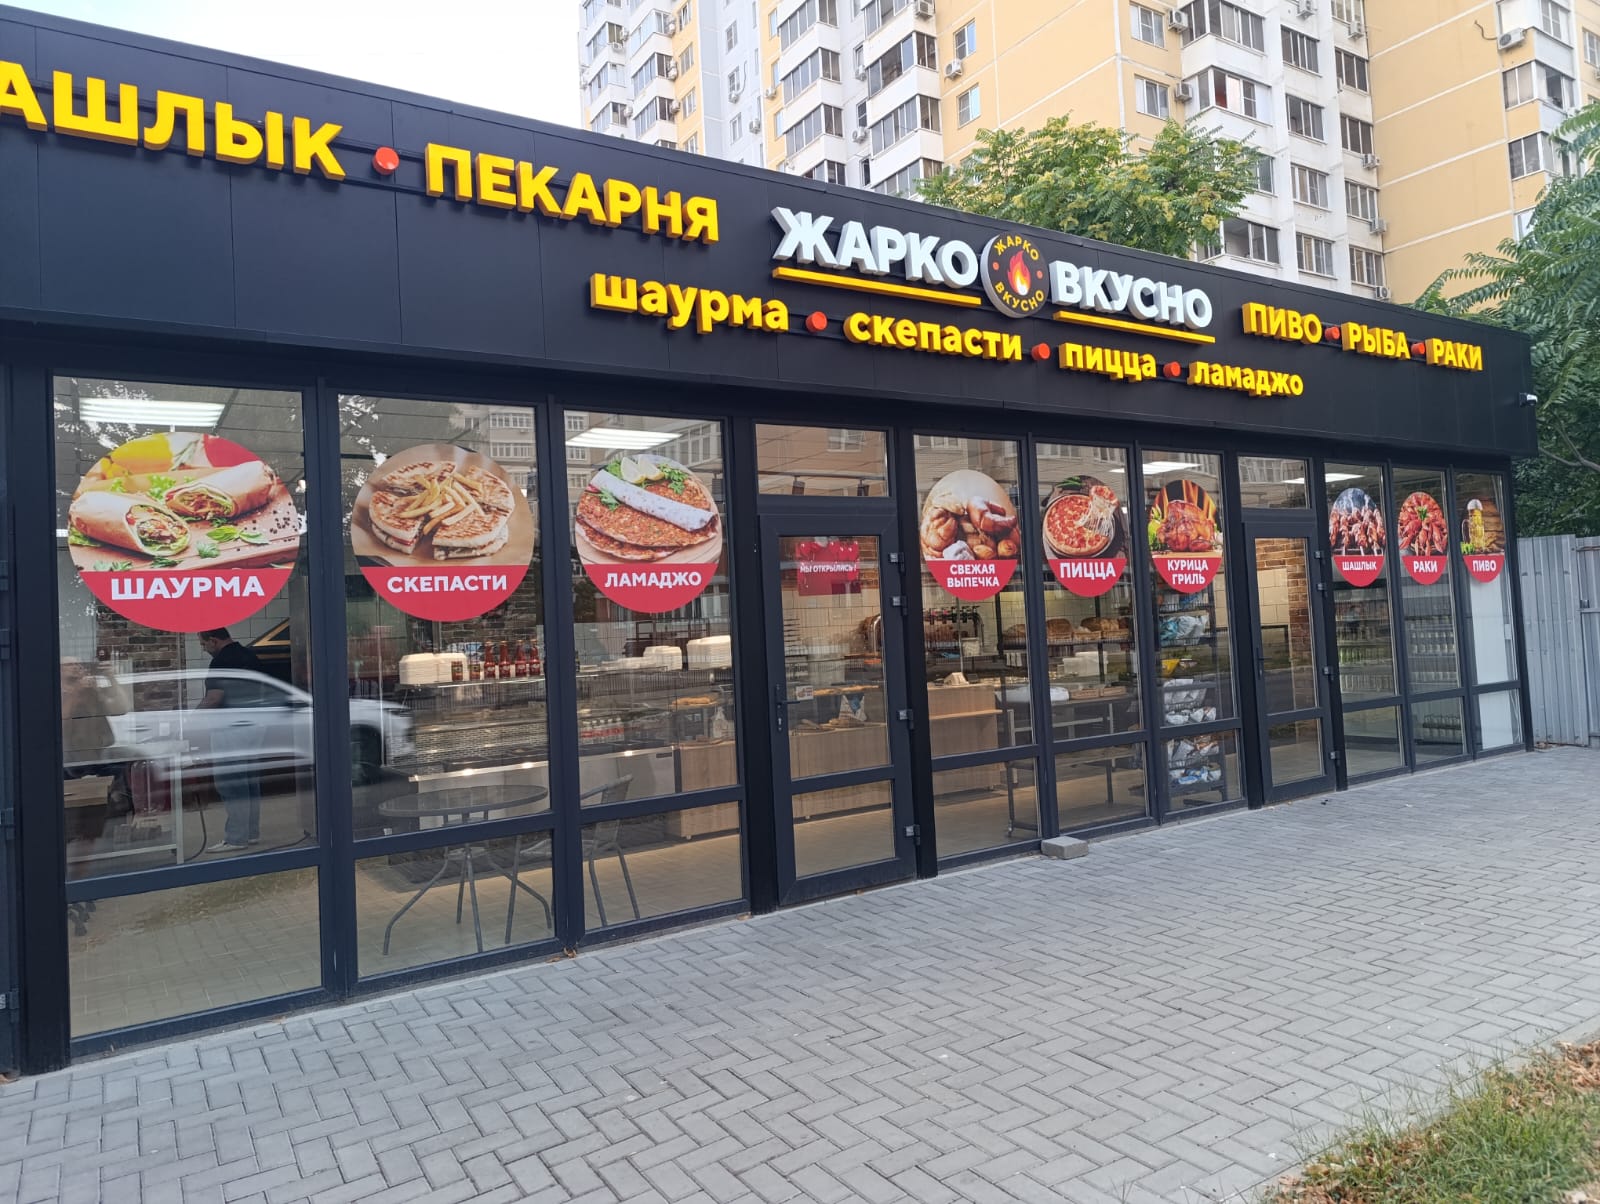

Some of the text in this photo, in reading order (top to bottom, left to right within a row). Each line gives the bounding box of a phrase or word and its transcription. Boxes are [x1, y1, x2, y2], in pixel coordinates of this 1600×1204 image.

[0, 60, 720, 244] АШЛЫК ПЕКАРНЯ
[994, 235, 1039, 261] ЖАРКО
[771, 206, 1213, 329] ЖАРКО ВКУСНО
[995, 281, 1044, 311] ВКУСНО
[590, 272, 1304, 397] шаурма скепасти пицца ламаджо
[1242, 302, 1482, 372] ПИВО РЫБА РАКИ
[949, 563, 995, 576] СВЕЖАЯ
[1060, 562, 1116, 579] ПИЦЦА
[1167, 559, 1208, 572] КУРИЦА
[1342, 561, 1376, 571] ШАШЛЫК
[1413, 560, 1438, 573] РАКИ
[1472, 560, 1497, 572] ПИВО
[111, 575, 264, 601] ШАУРМА
[387, 573, 507, 593] СКЕПАСТИ
[604, 571, 702, 590] ЛАМАДЖО
[947, 576, 1000, 588] ВЫПЕЧКА
[1171, 572, 1206, 586] ГРИЛЬ
